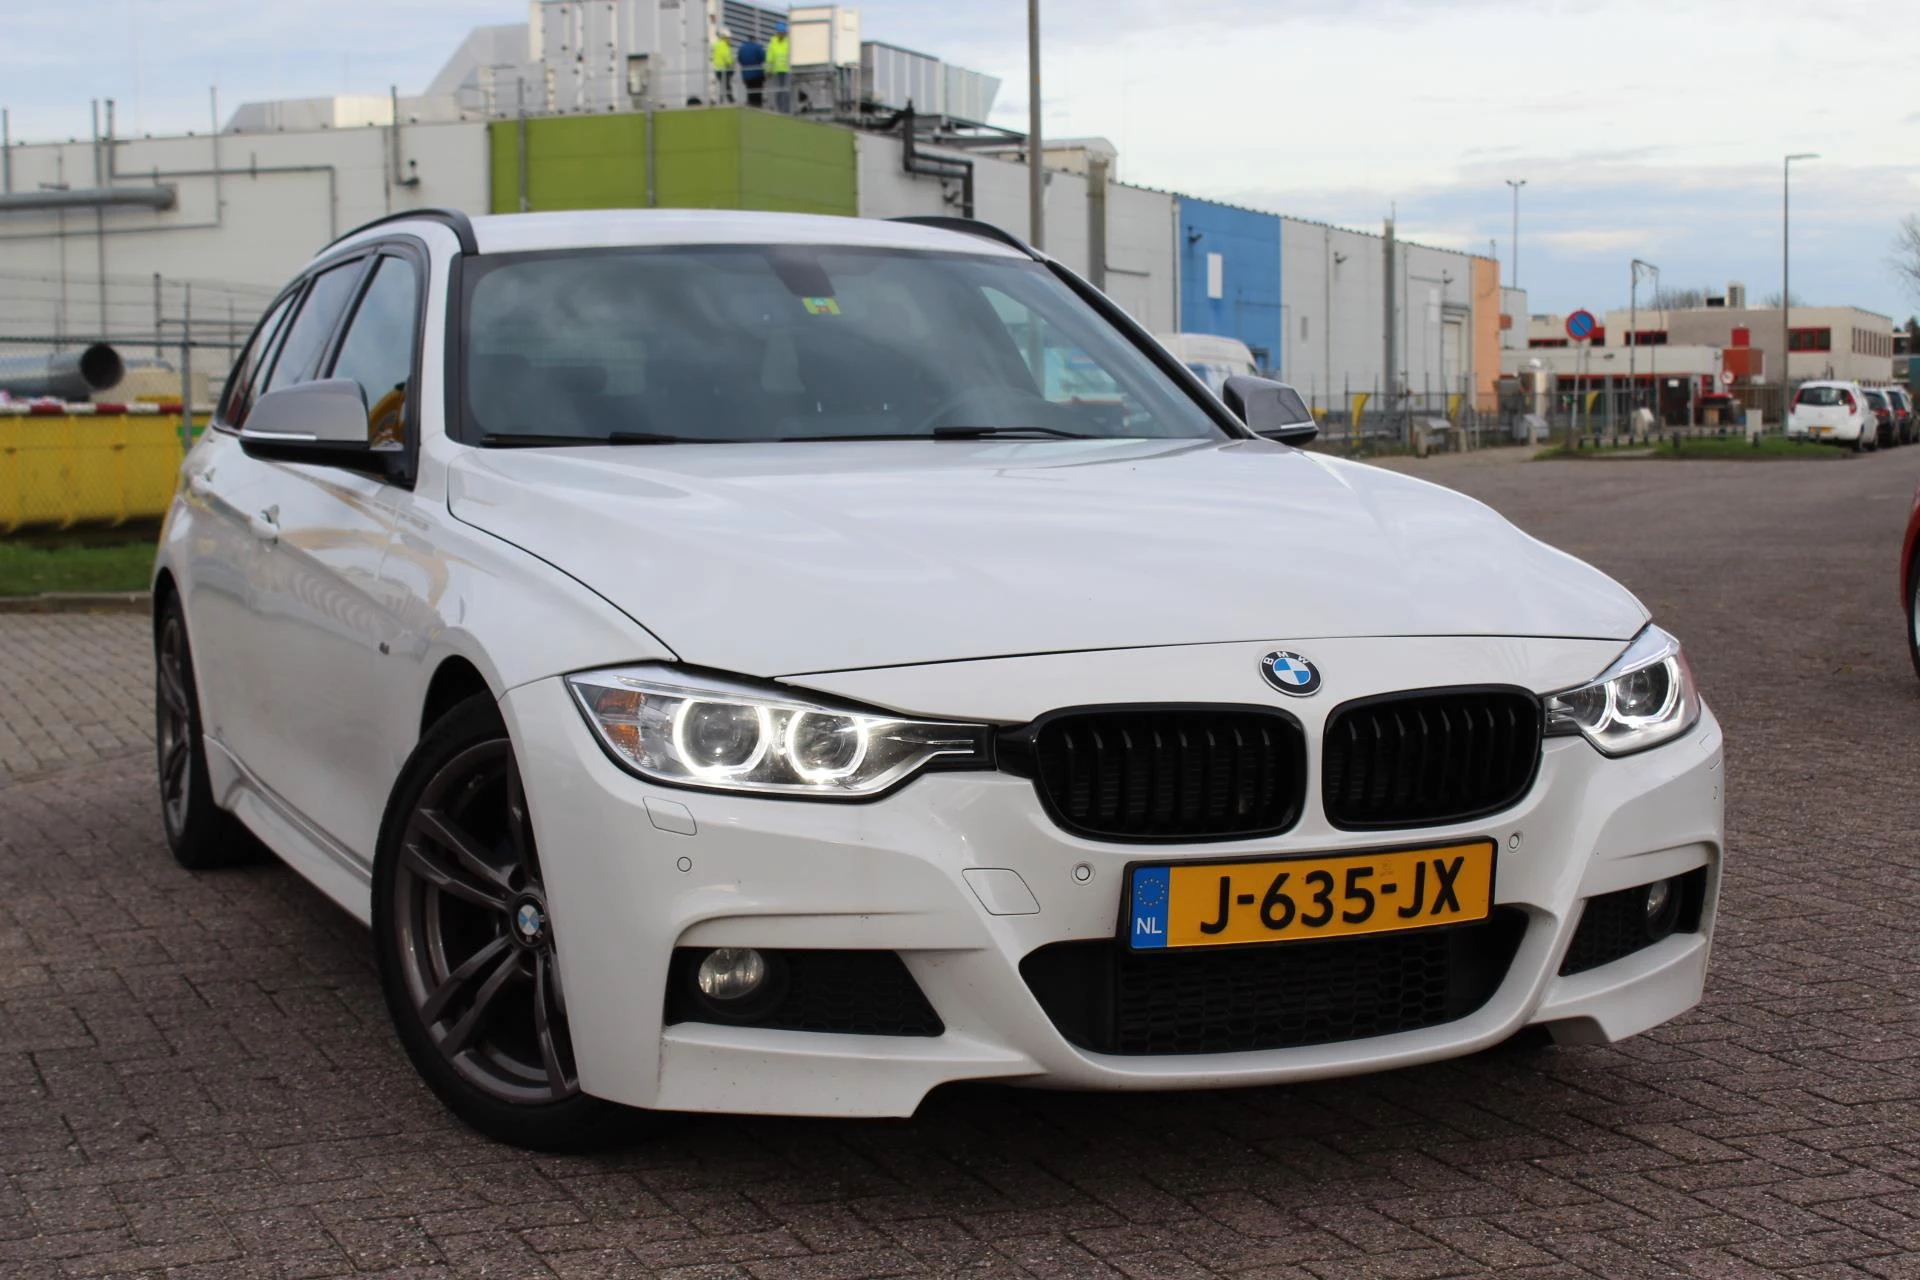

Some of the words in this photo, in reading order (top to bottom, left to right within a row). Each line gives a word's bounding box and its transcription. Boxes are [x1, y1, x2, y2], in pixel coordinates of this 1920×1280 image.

[1263, 651, 1309, 665] BMW
[1200, 856, 1465, 935] J-635-JX
[1136, 917, 1163, 935] NL
